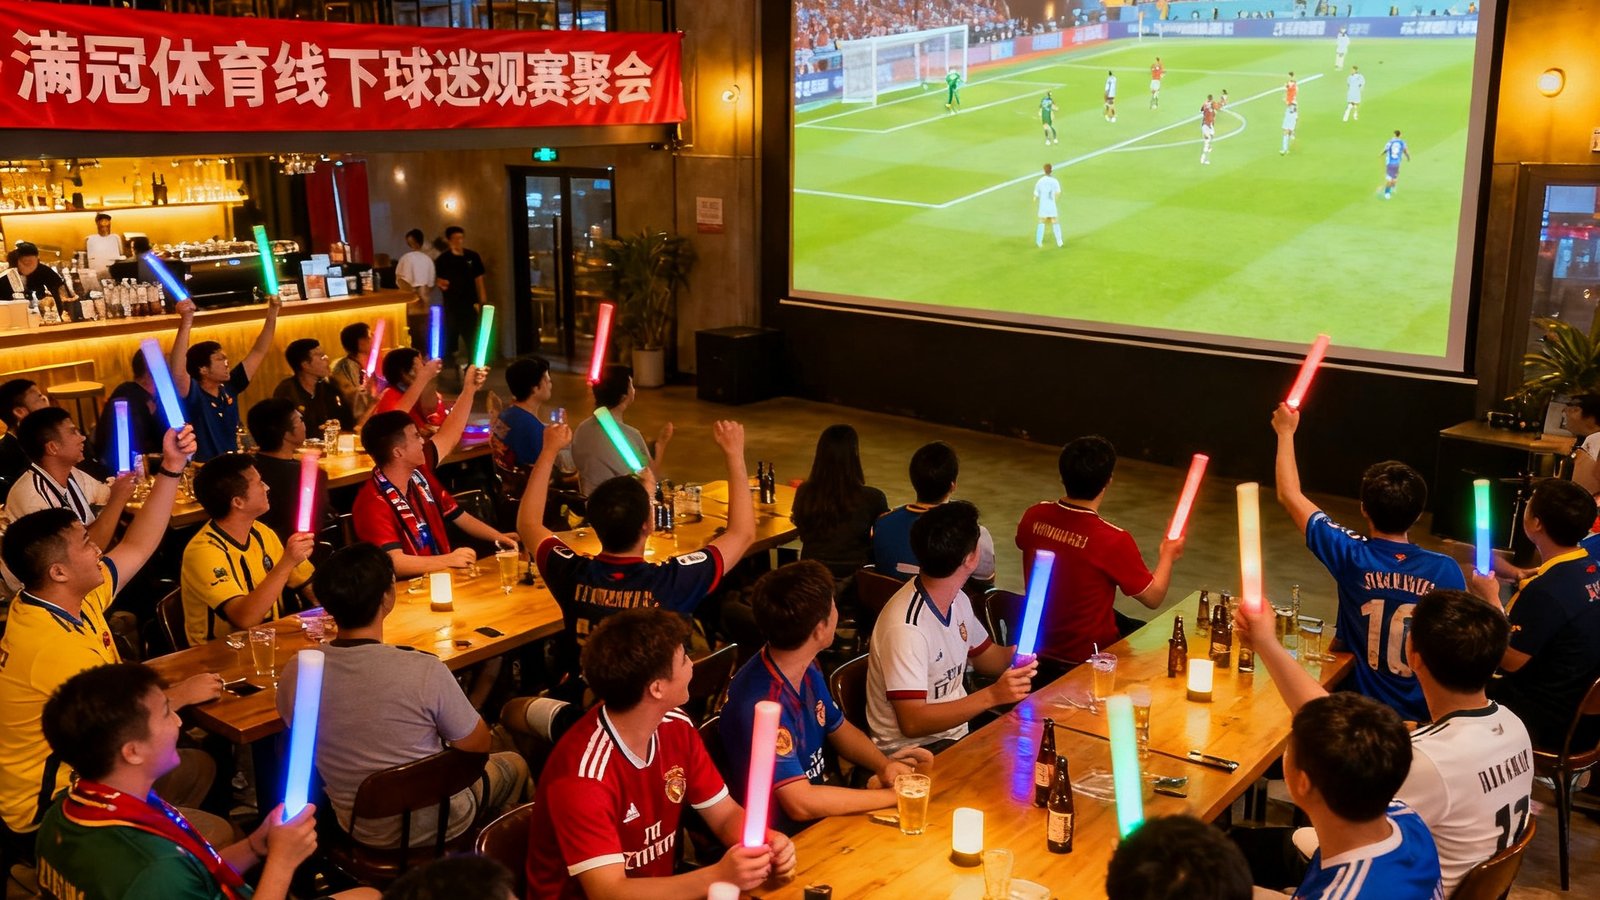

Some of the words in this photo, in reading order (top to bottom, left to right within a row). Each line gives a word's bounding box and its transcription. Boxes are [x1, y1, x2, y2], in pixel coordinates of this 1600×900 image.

[11, 29, 653, 108] 满冠体育线下球迷观赛聚会
